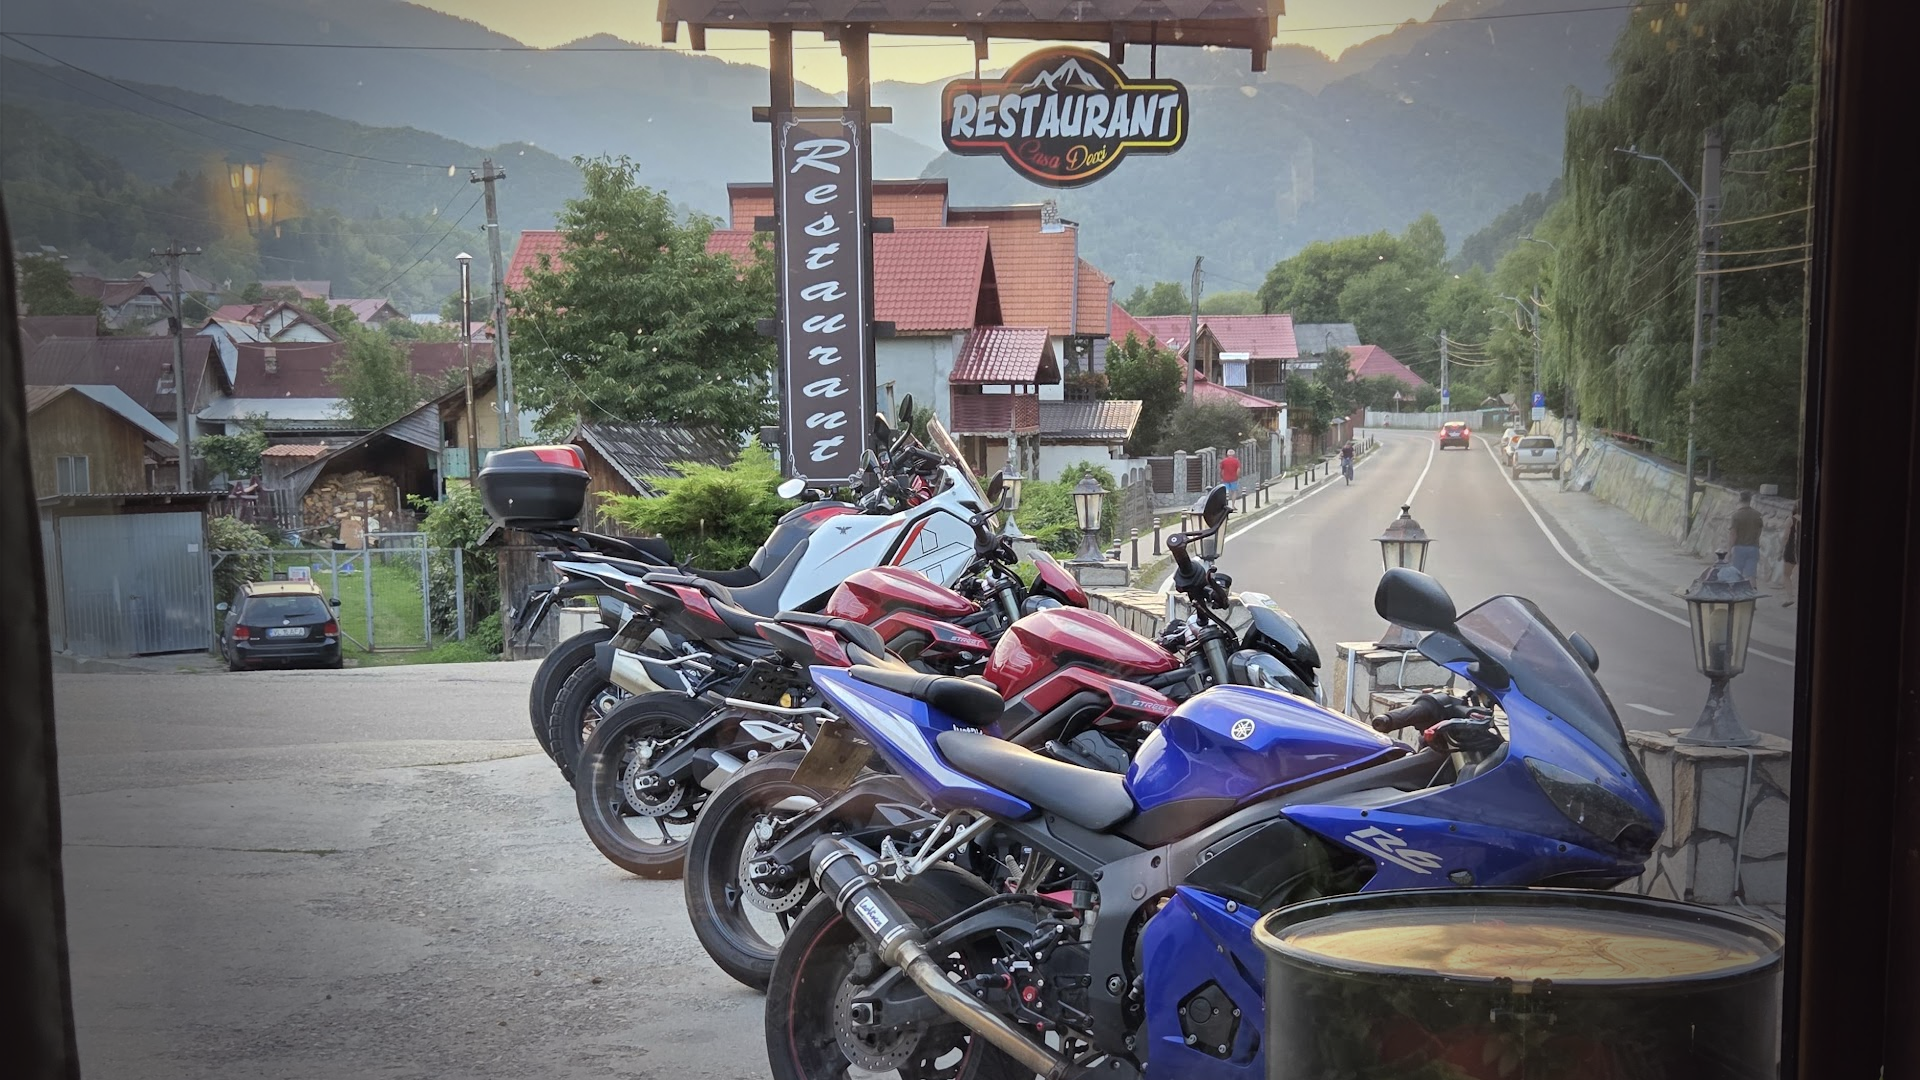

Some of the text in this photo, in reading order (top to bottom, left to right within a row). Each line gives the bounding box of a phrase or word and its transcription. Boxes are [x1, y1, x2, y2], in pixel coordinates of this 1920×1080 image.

[951, 93, 1179, 139] RESTAURANT
[1018, 139, 1061, 169] Casa
[790, 138, 851, 463] Restaurant
[951, 635, 983, 647] STREET
[1131, 700, 1172, 715] STREET
[1345, 825, 1443, 874] R6
[859, 898, 883, 928] LeoVince
